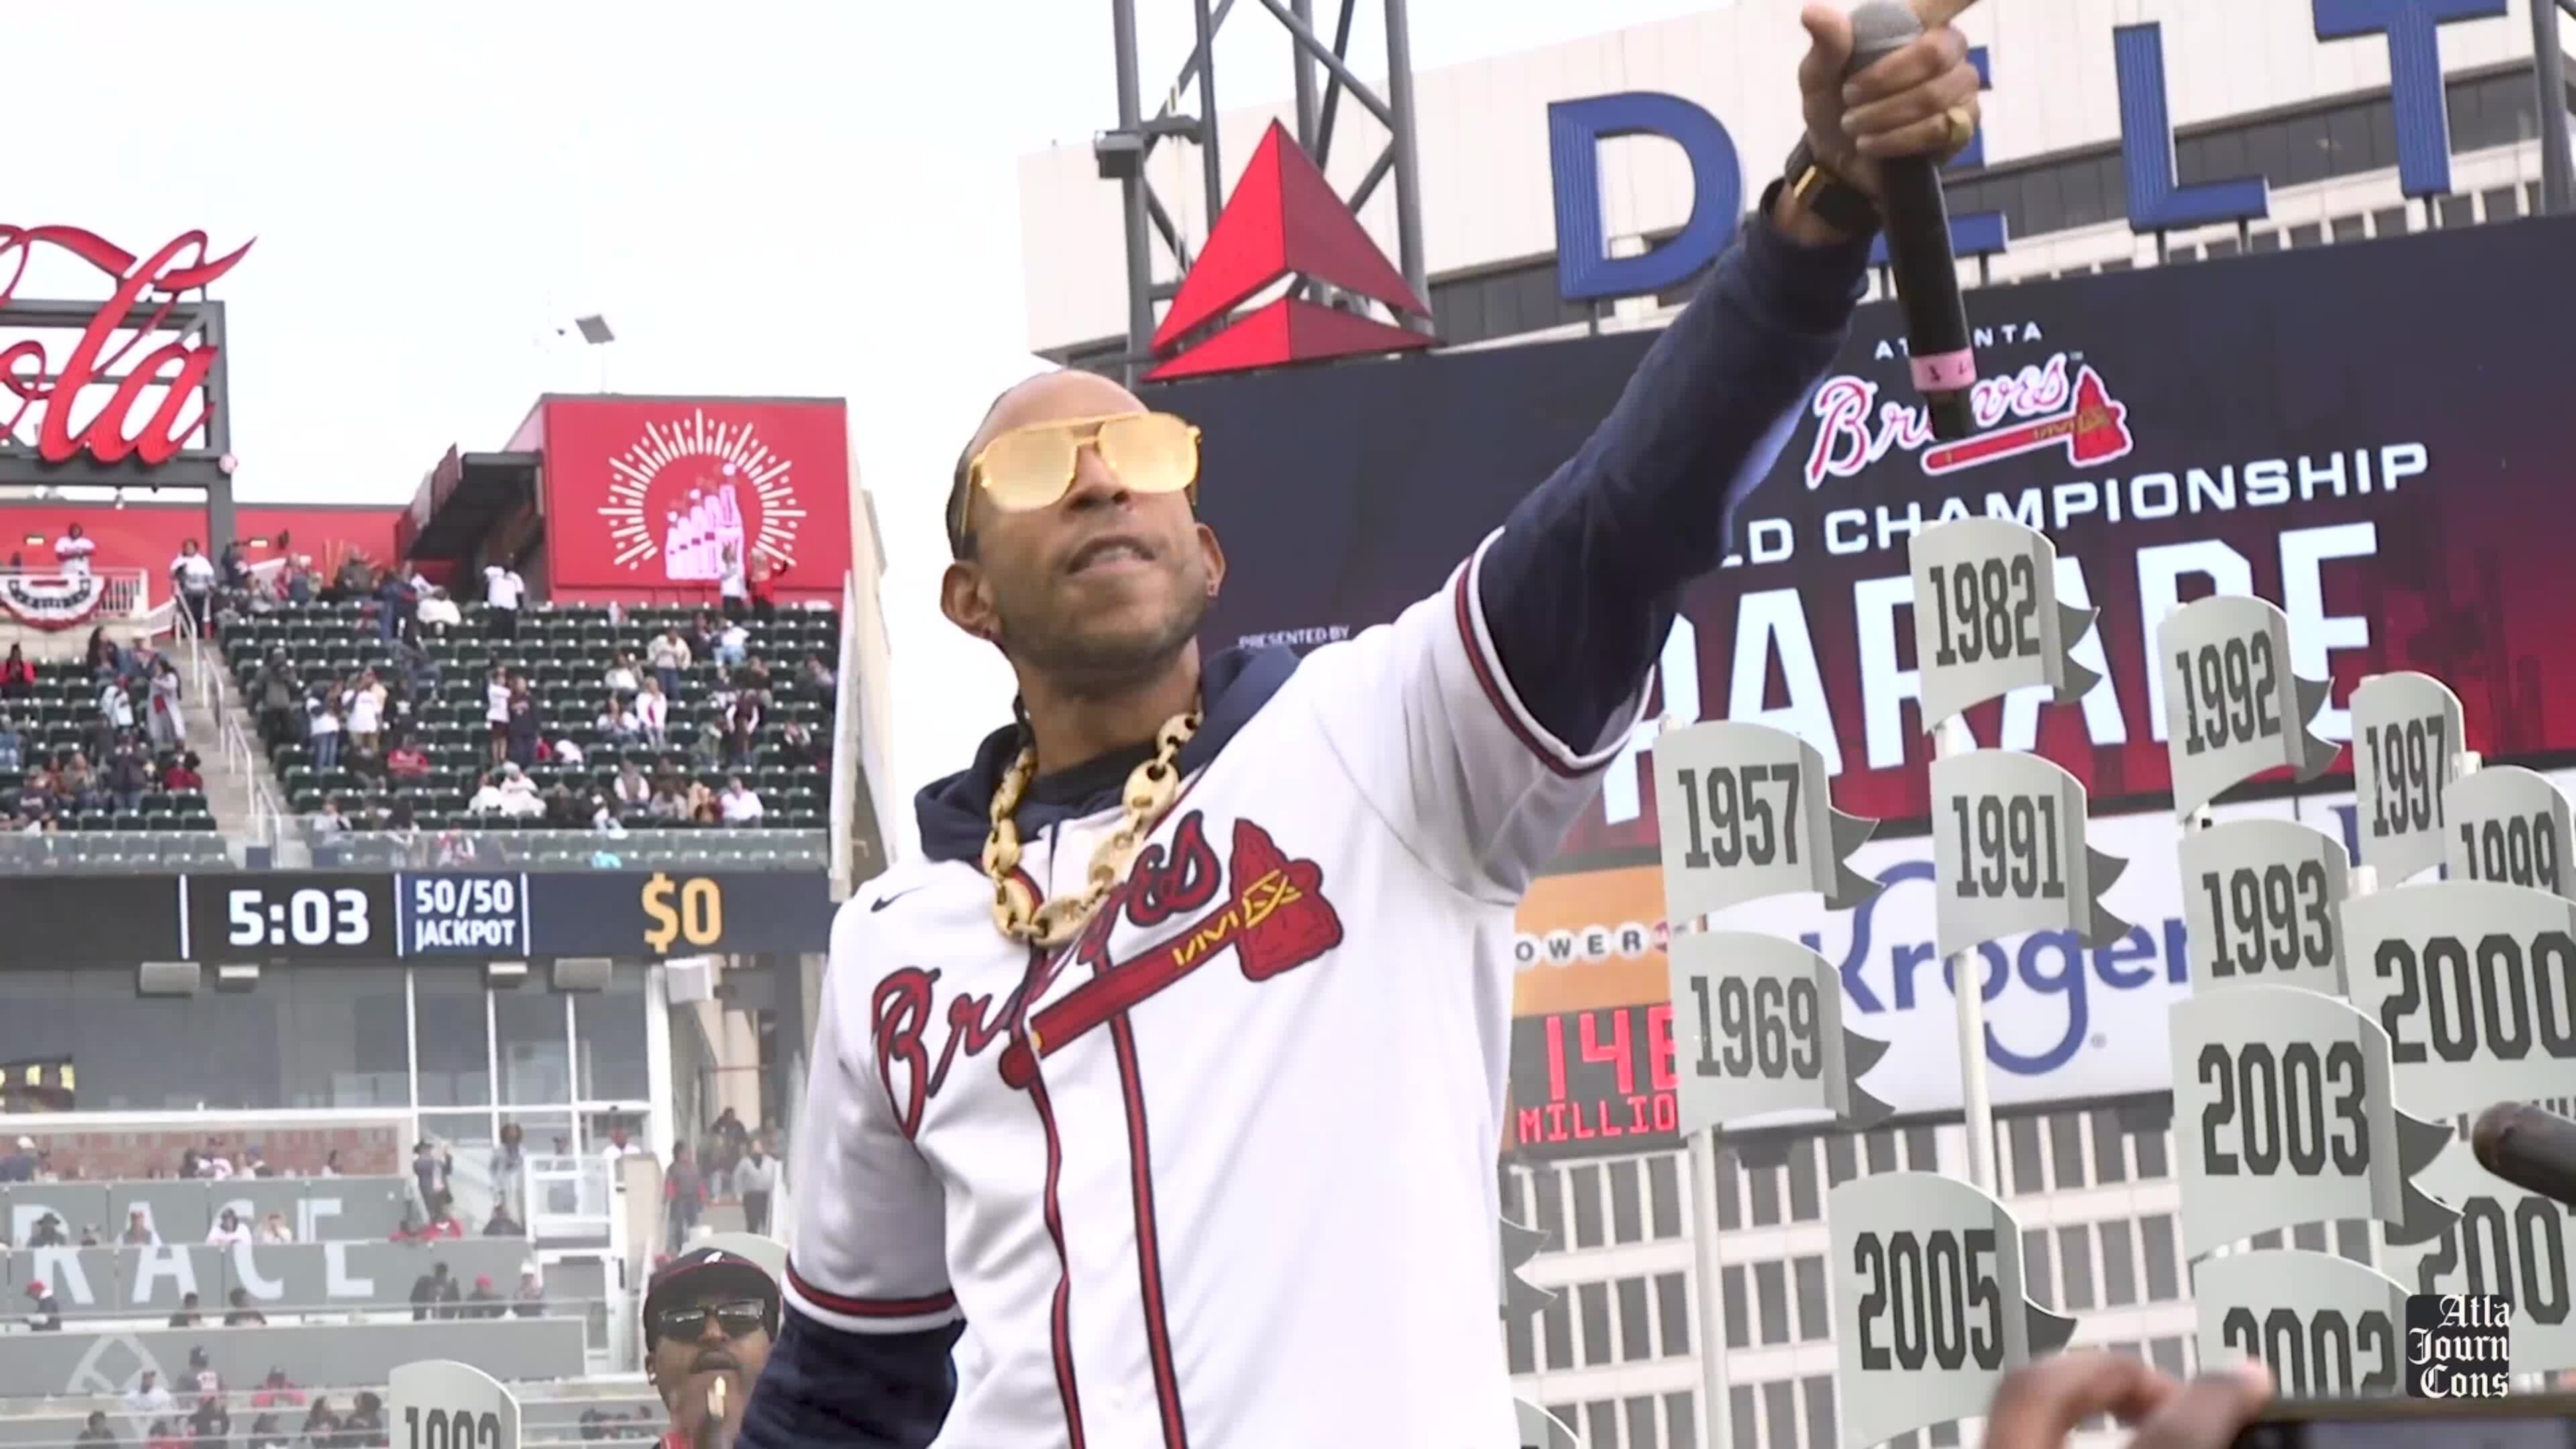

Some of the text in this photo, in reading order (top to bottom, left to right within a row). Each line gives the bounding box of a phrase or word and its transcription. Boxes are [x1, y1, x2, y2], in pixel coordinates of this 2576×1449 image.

[1548, 0, 2508, 302] DLT
[1874, 321, 2042, 360] ATNTA
[1238, 625, 1350, 649] PRESENTED BY
[1929, 553, 2041, 667] 1982
[2176, 630, 2282, 756] 1992
[1678, 763, 1800, 869] 1957
[2365, 715, 2445, 838] 1997
[415, 878, 514, 914] 50/50
[1952, 795, 2065, 899] 1991
[228, 889, 370, 945] 5:03
[415, 918, 515, 951] JACKPOT
[641, 873, 722, 953] $0
[2202, 859, 2334, 977] 1993
[1690, 975, 1823, 1080] 1969
[2374, 930, 2576, 1064] 2000
[1519, 1093, 1675, 1145] MILLIO
[2198, 1041, 2370, 1176] 2003
[1854, 1229, 2005, 1371] 2005
[2418, 1195, 2576, 1326] 200
